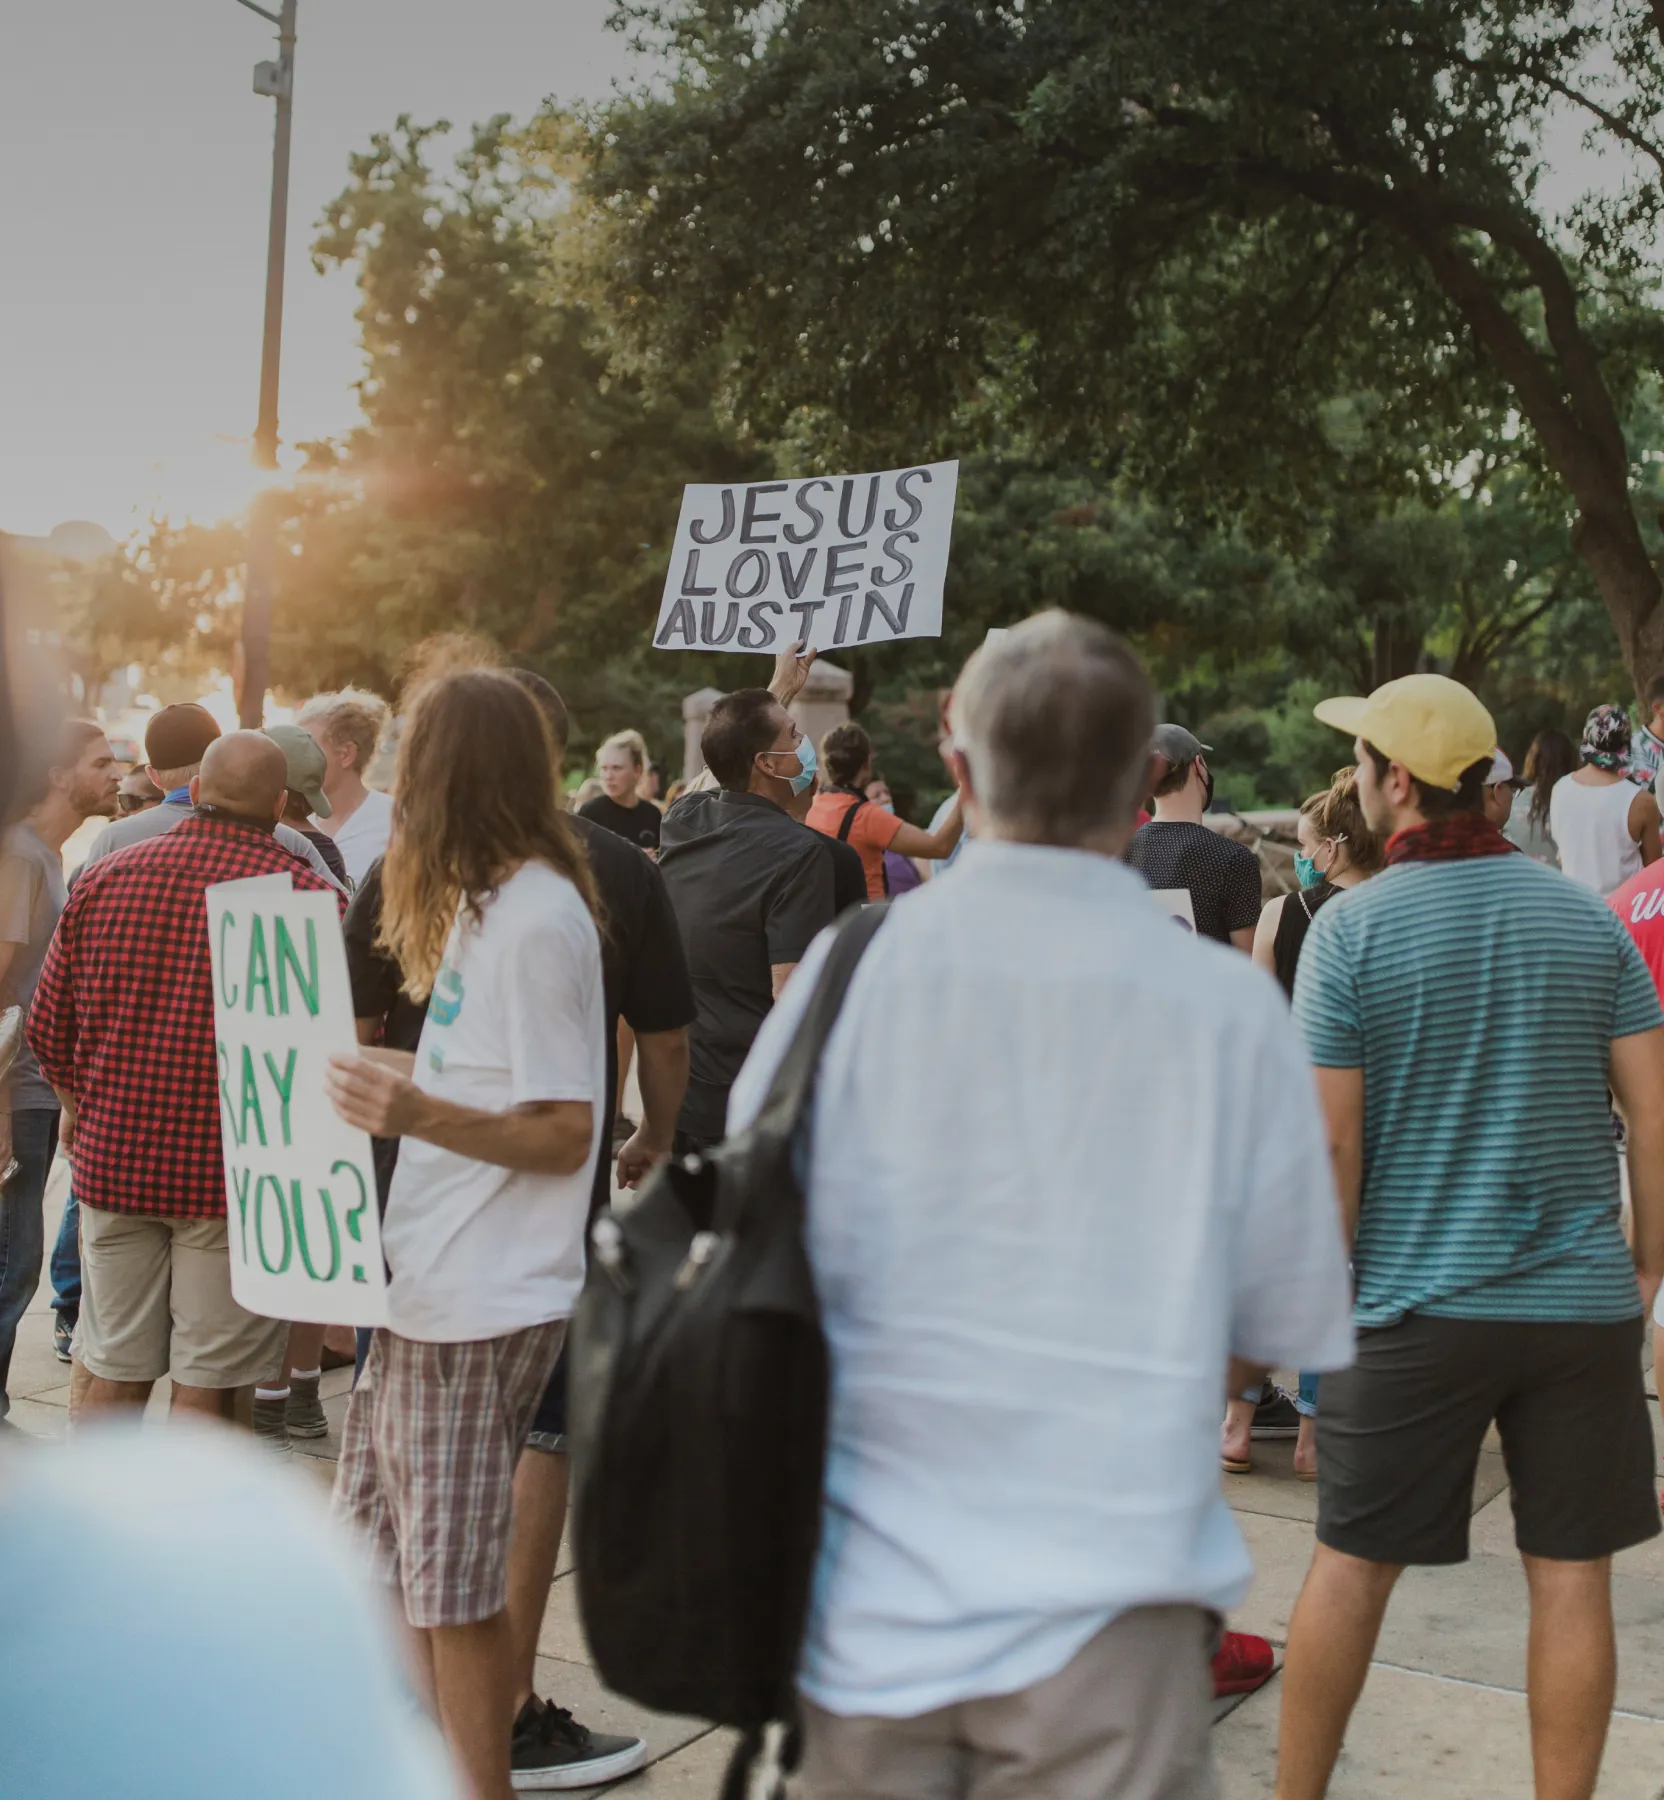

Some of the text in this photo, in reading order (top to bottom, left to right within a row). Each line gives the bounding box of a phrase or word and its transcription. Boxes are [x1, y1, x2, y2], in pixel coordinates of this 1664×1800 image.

[690, 468, 932, 544] JESUS
[681, 530, 920, 599] LOVES
[656, 583, 915, 653] AUSTIN
[1630, 888, 1664, 923] W
[220, 910, 319, 1017] CAN
[232, 1160, 369, 1284] YOU?
